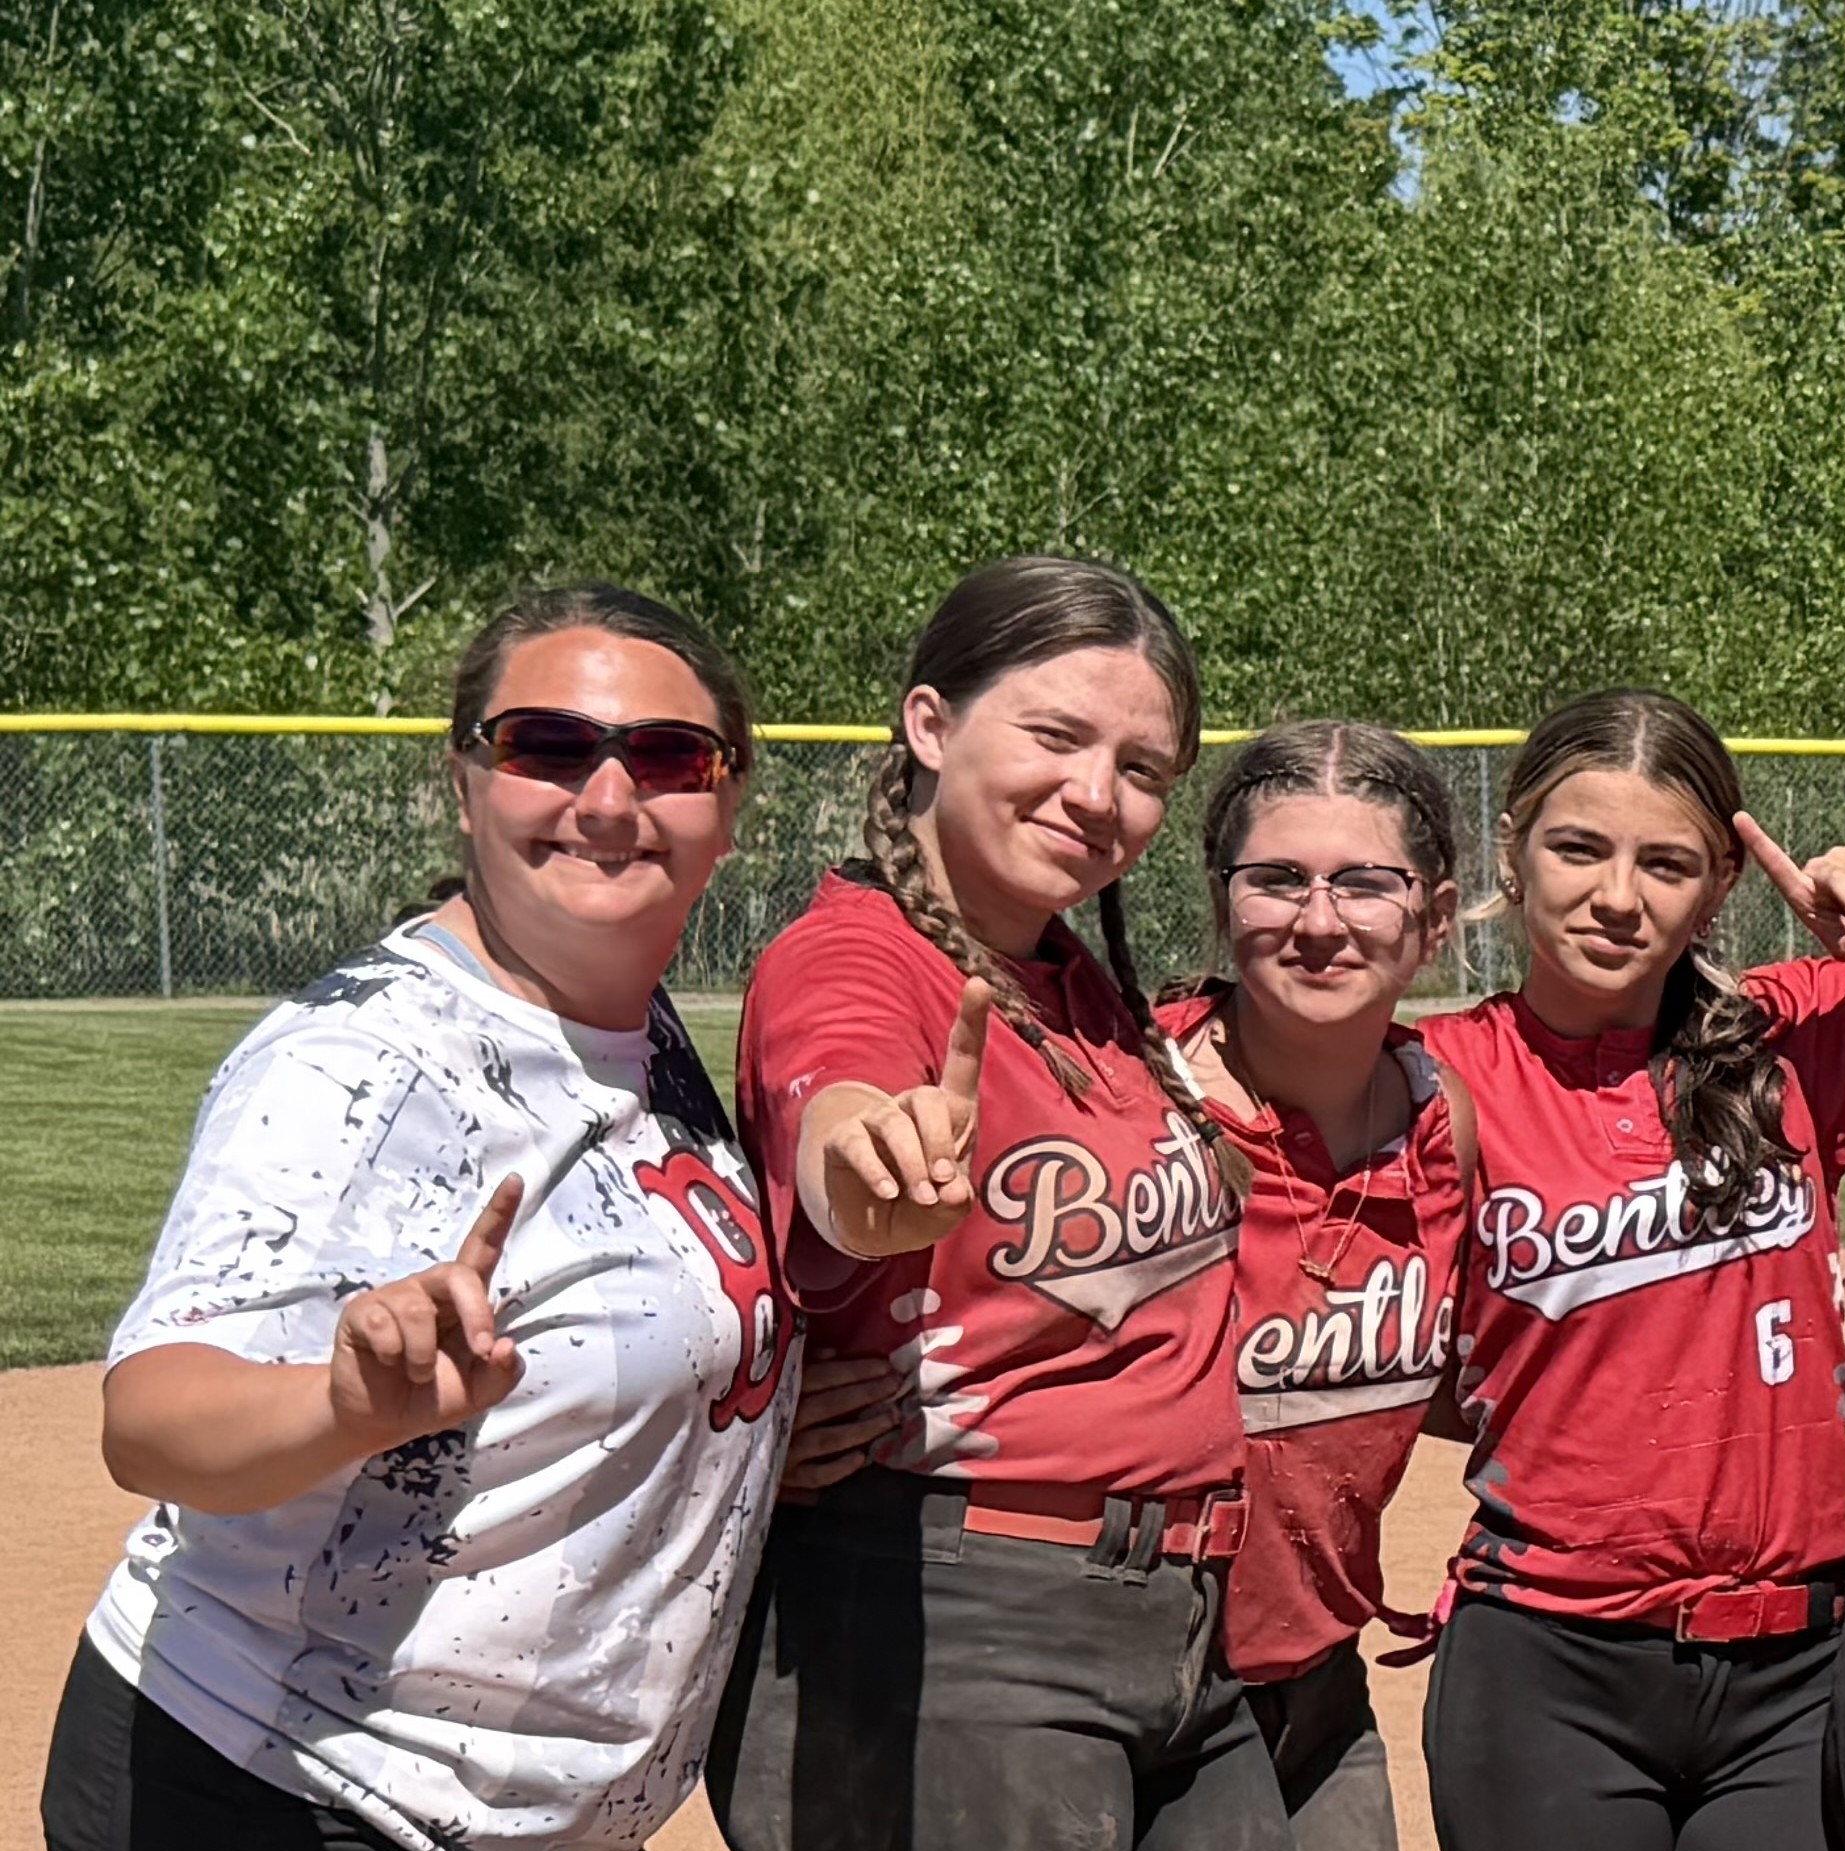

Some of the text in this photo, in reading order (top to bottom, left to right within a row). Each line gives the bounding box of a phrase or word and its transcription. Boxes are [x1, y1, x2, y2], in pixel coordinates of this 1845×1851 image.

[987, 1110, 1243, 1278] Bent
[632, 1149, 795, 1433] B
[1237, 1255, 1454, 1390] entle
[1755, 1300, 1794, 1385] 6
